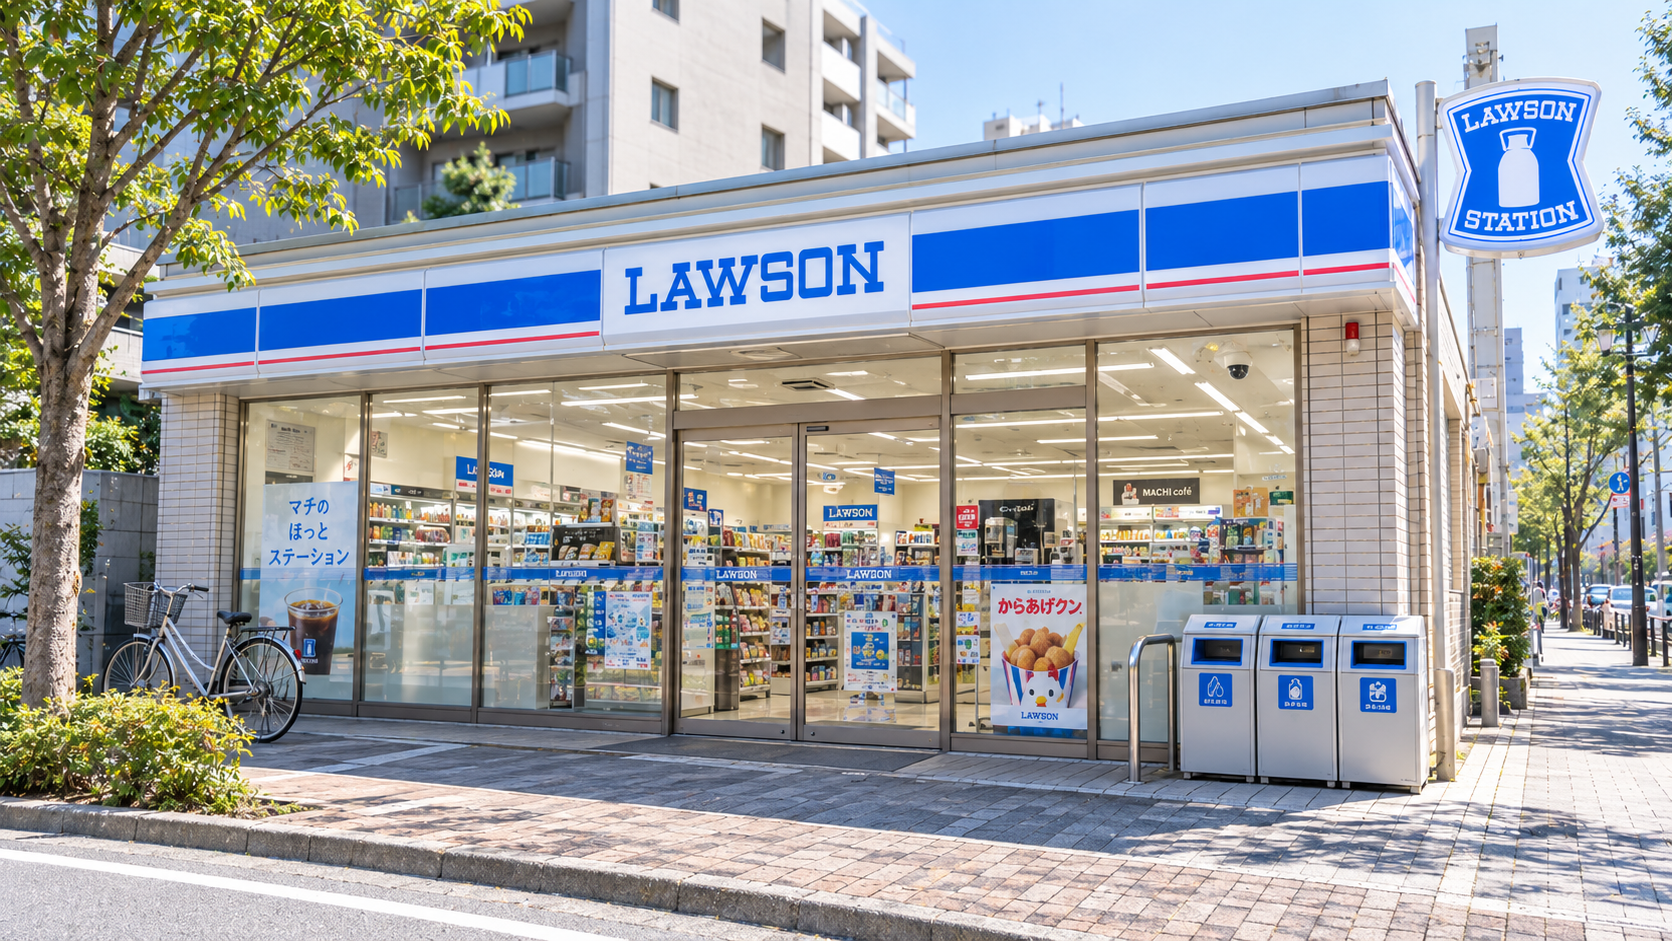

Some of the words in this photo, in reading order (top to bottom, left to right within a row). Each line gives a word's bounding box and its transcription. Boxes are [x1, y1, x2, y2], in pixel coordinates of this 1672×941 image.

[1461, 100, 1577, 133] LAWSON
[1464, 200, 1579, 232] STATION
[624, 240, 885, 315] LAWSON
[1142, 488, 1172, 497] MACHI
[289, 497, 330, 516] マチの
[829, 508, 873, 518] LAWSON
[289, 521, 328, 541] ほっと
[268, 547, 350, 566] ステーション
[1021, 711, 1059, 720] LAWSON
